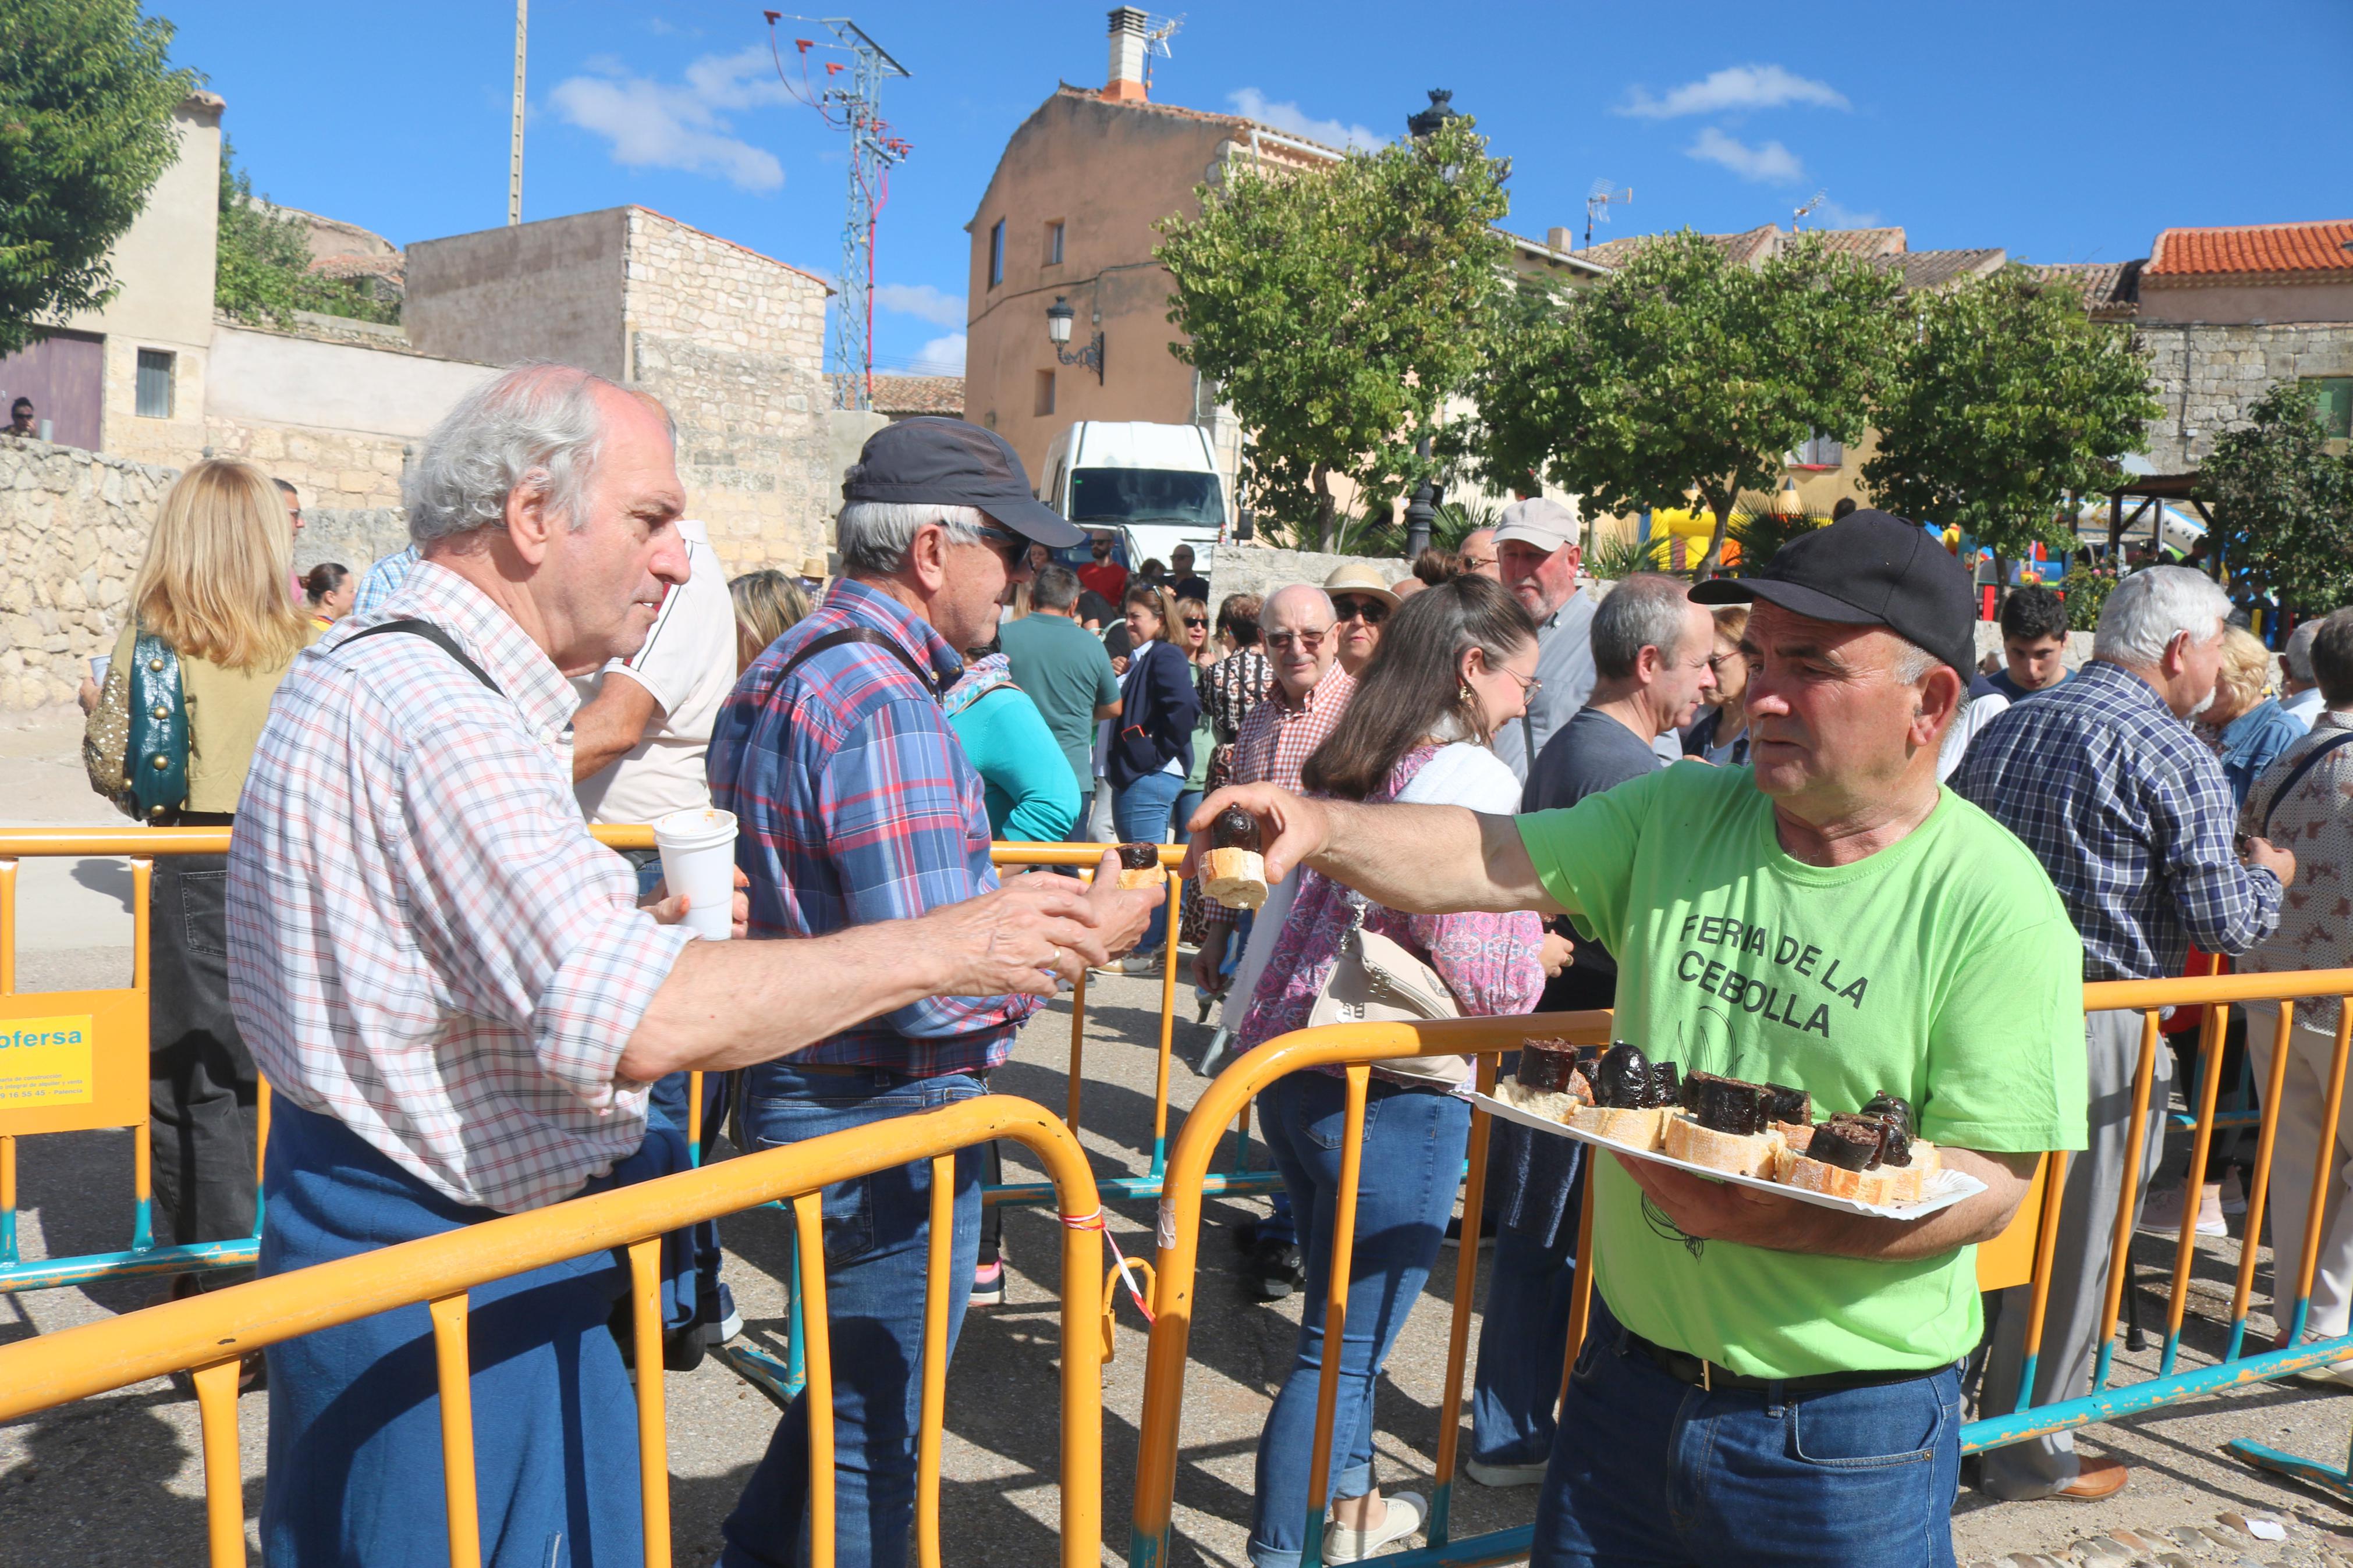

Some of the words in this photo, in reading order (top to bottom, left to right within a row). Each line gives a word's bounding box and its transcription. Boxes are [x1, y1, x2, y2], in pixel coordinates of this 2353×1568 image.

[1677, 950, 1830, 1038] CEBOLLA
[1680, 914, 1766, 957] FERIA
[1774, 935, 1823, 977] DE
[1820, 959, 1869, 1009] LA
